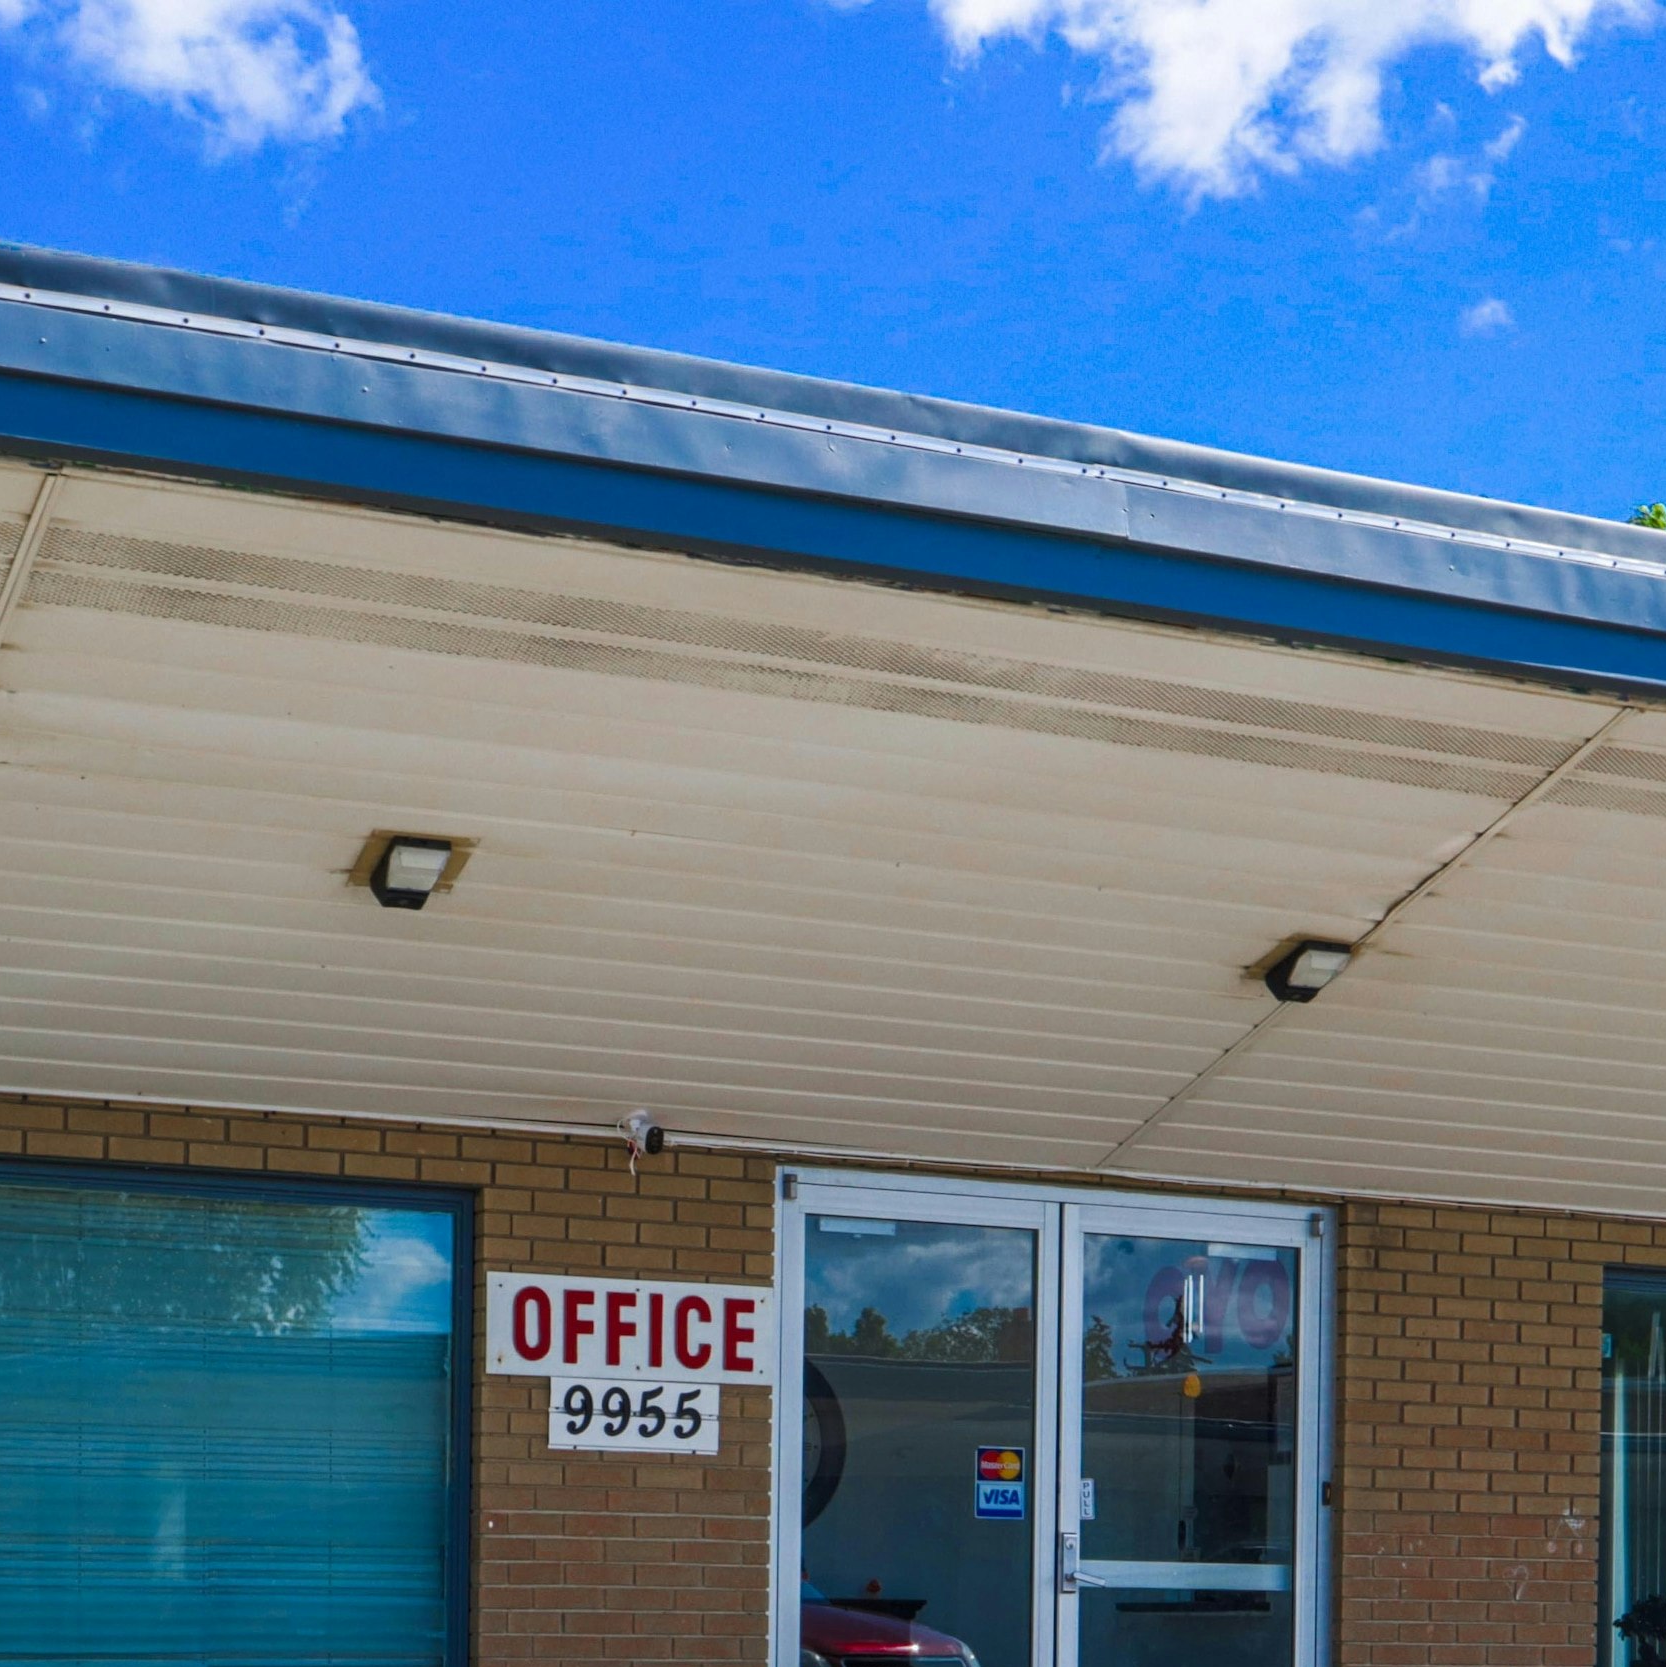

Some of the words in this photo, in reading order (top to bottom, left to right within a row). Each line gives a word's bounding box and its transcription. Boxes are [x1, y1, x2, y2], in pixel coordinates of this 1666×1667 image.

[512, 1286, 755, 1372] OFFICE
[1143, 1257, 1290, 1358] OYO
[563, 1384, 702, 1439] 9955
[983, 1489, 1020, 1505] VISA
[1082, 1482, 1091, 1516] PULL
